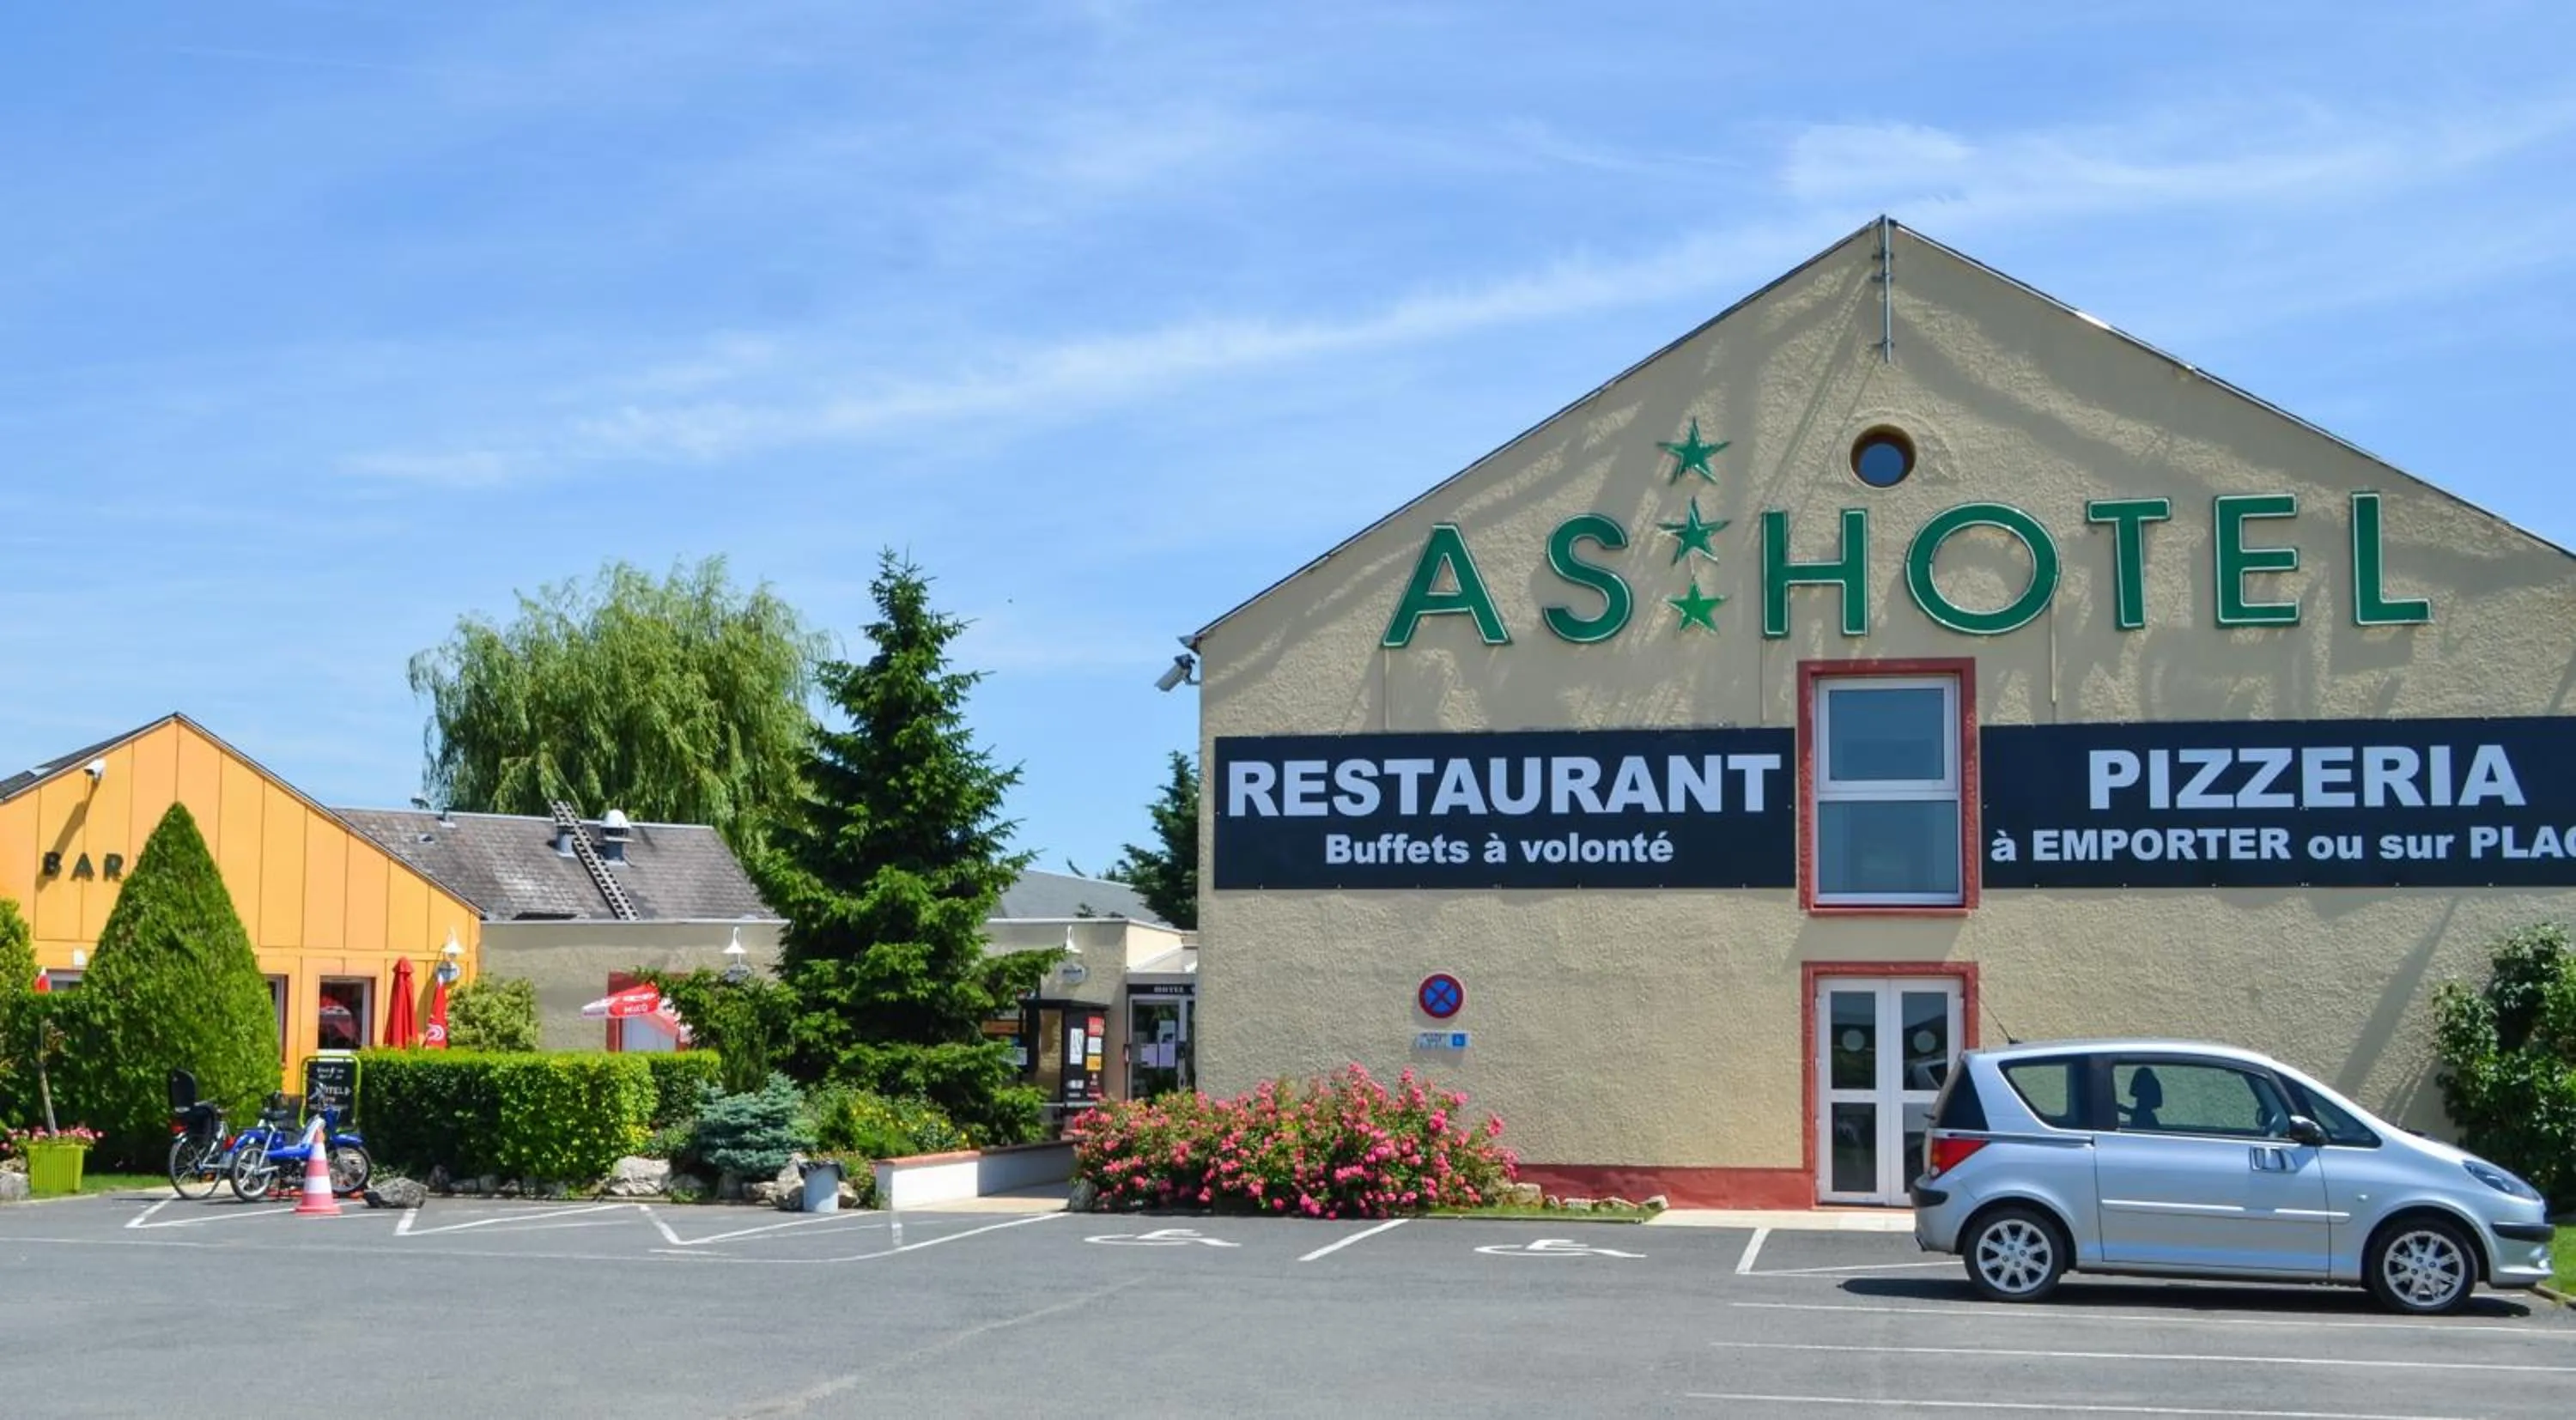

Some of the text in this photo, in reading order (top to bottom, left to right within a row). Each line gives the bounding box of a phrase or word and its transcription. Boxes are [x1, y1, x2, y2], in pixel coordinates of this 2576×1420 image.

[1380, 492, 2432, 647] AS HOTEL
[1228, 754, 1781, 817] RESTAURANT
[2089, 744, 2526, 810] PIZZERIA
[42, 852, 124, 882] BAR
[1326, 831, 1674, 865] Buffets à volonté
[1990, 829, 2017, 862] à
[2032, 827, 2292, 861] EMPORTER
[2307, 834, 2363, 859] ou
[2379, 834, 2455, 859] sur
